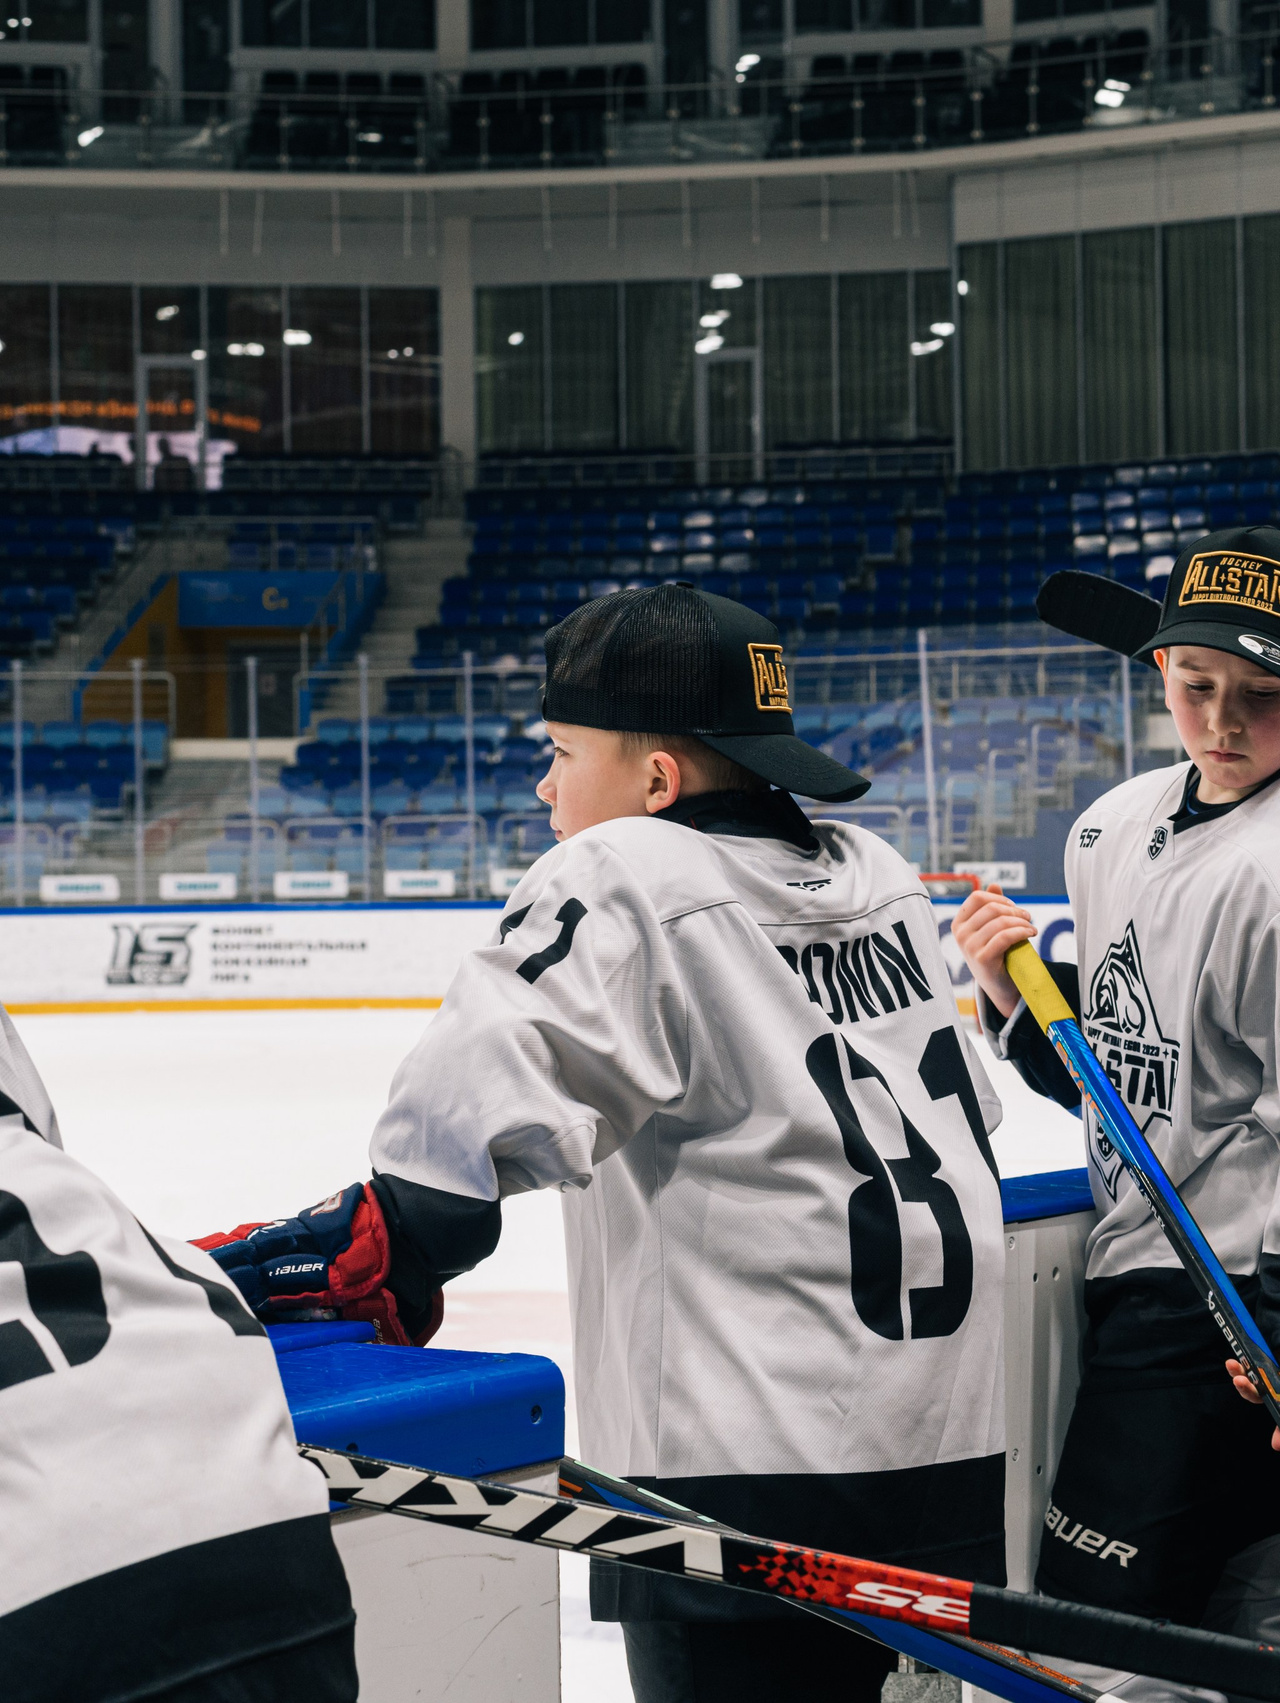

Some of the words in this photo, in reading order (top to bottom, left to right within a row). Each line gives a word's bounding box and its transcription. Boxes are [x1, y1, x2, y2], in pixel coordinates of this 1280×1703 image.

[1219, 556, 1263, 571] HOCKEY
[1256, 599, 1274, 612] 2023
[777, 919, 935, 1027] ONIN
[1142, 1044, 1160, 1057] 2023
[805, 1024, 1002, 1341] 81
[1044, 1498, 1139, 1568] AUER
